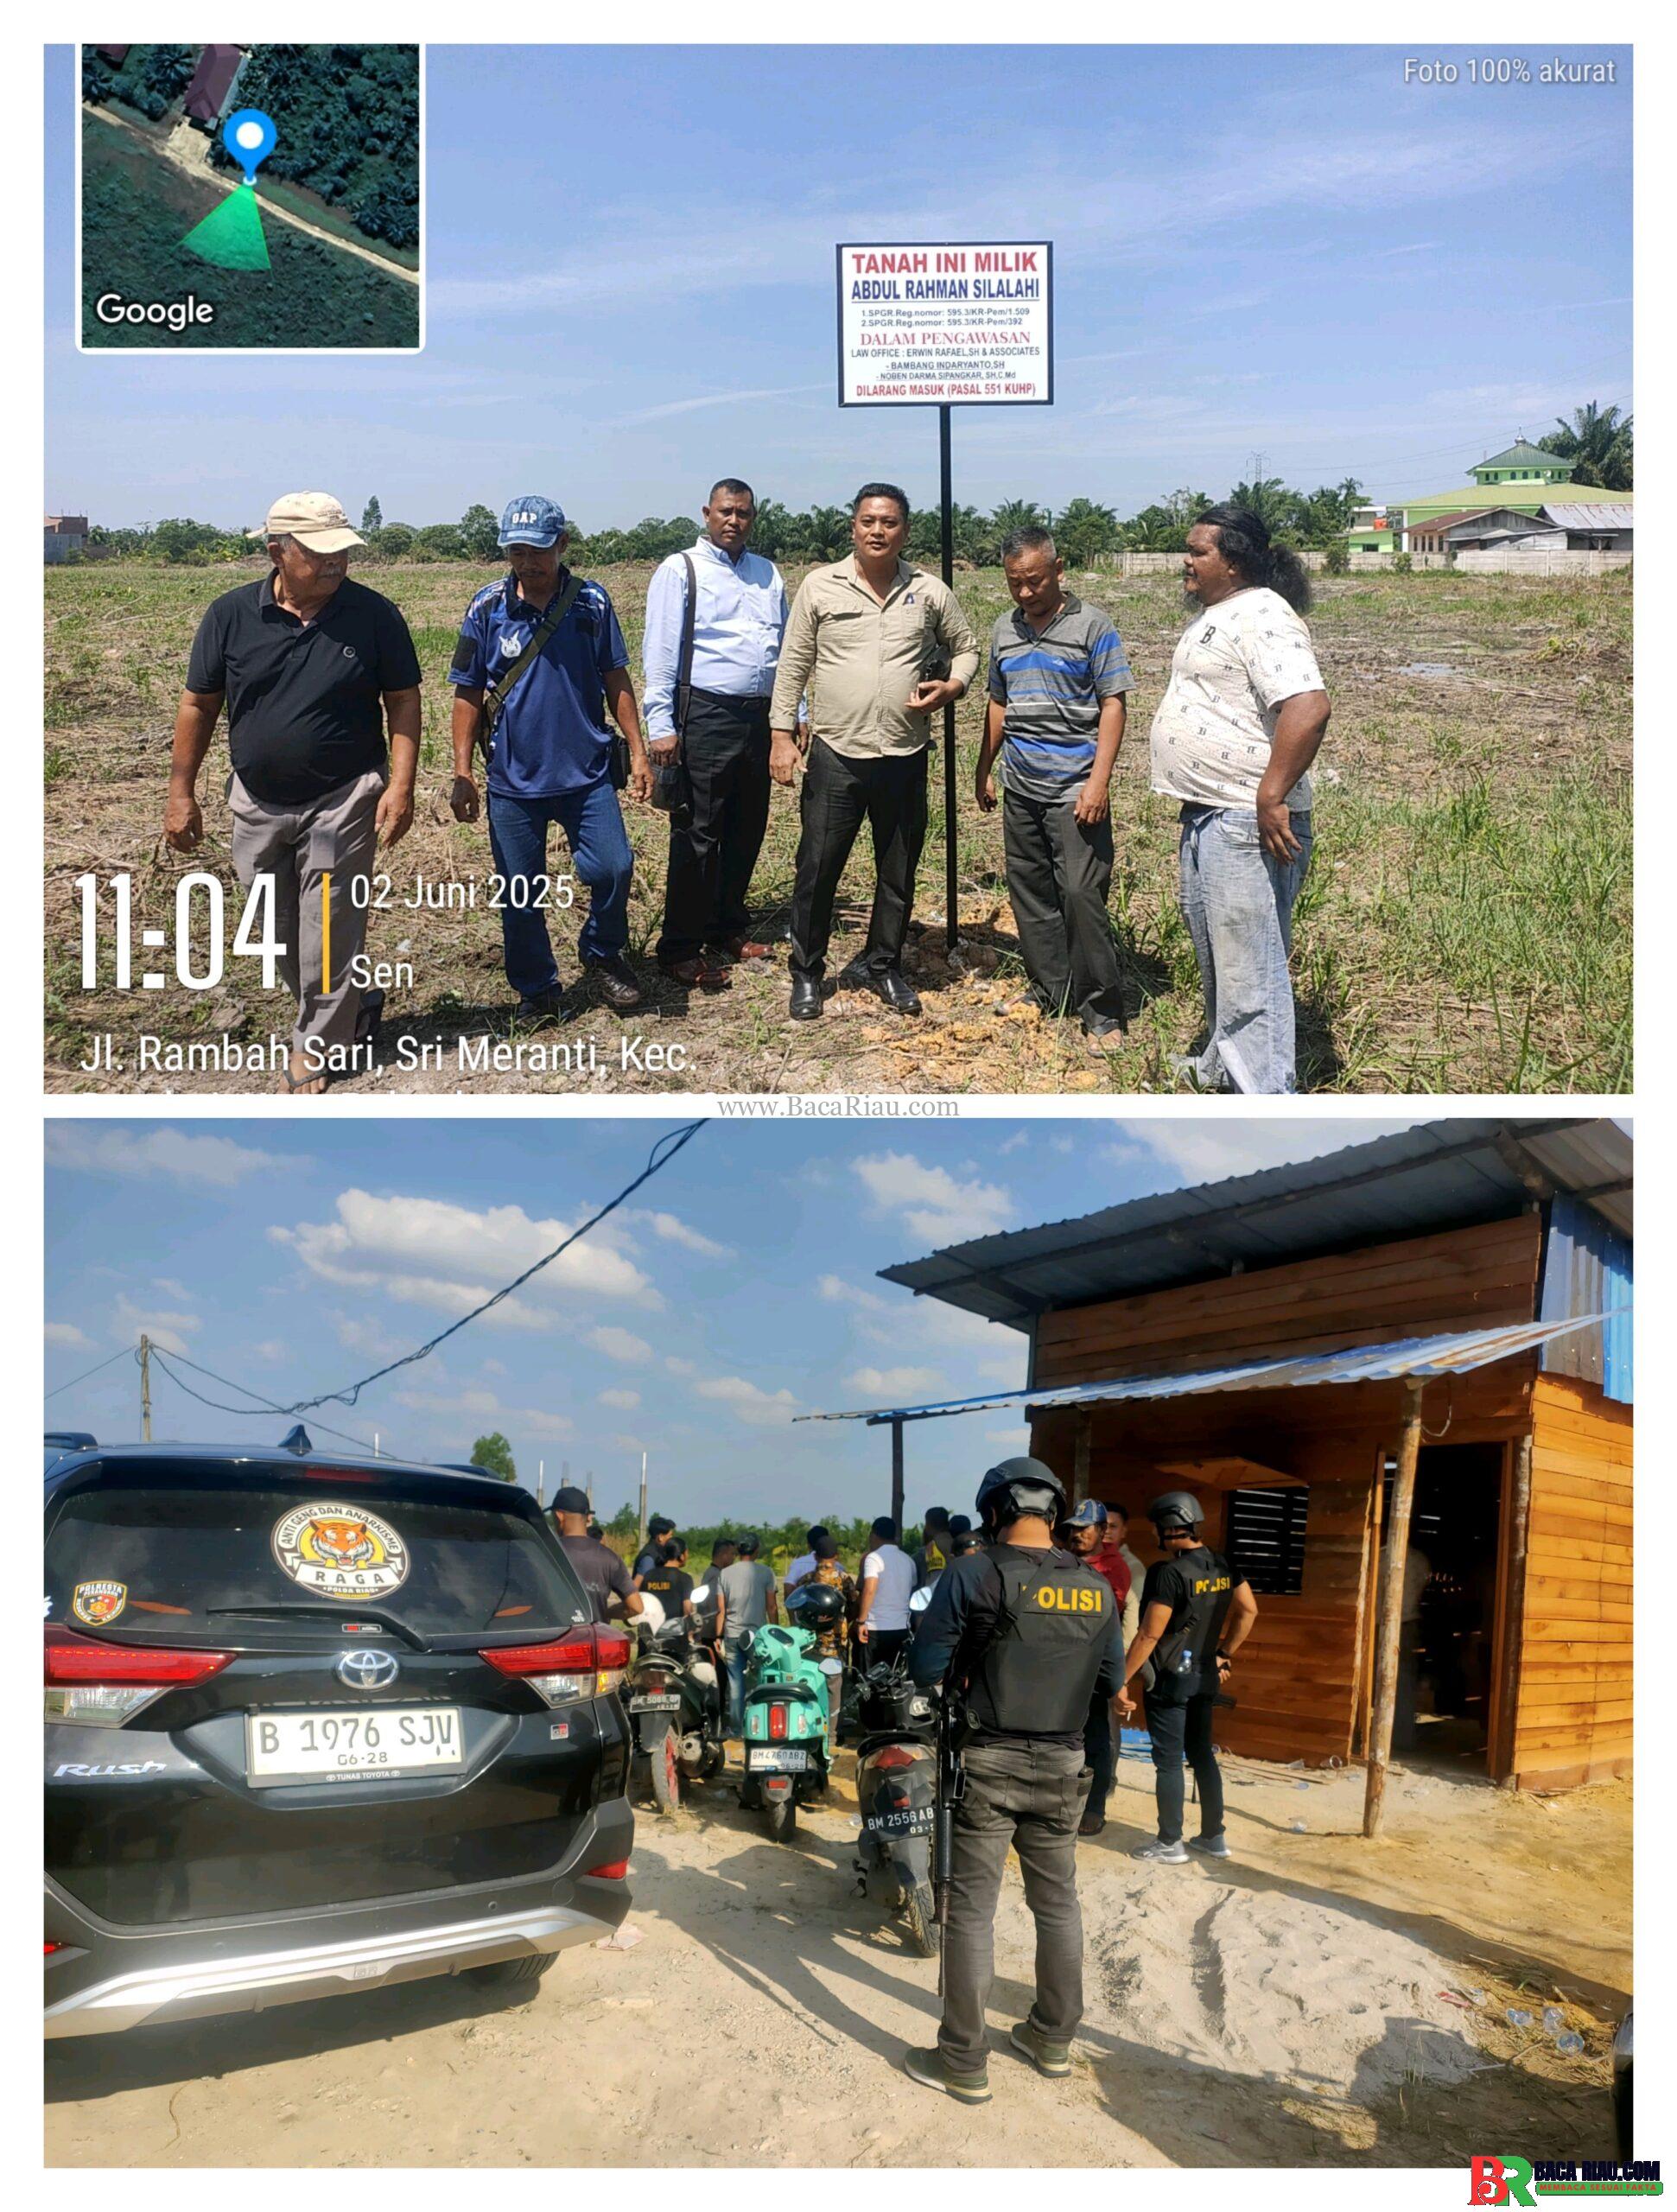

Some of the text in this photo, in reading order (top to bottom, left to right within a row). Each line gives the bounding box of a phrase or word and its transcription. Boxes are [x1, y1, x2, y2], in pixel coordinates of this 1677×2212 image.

[852, 251, 1038, 274] TANAH INI MILIK
[851, 278, 1039, 300] ABDUL RAHMAN SILALAHI
[860, 331, 1031, 346] DALAM PENGAWASAN
[871, 349, 899, 358] OFFICE
[906, 348, 933, 357] ERWIN
[981, 347, 988, 356] &
[989, 346, 1039, 356] ASSOCIATES
[856, 383, 1036, 397] DILARANG MASUK (PASAL 551 KUHP)
[282, 1507, 399, 1550] ANTI GENG DAN ANARKISME
[315, 1572, 384, 1584] RAGA
[1023, 1585, 1102, 1612] OLISI
[260, 1722, 279, 1753] B
[300, 1718, 379, 1751] 1976
[753, 1751, 764, 1759] BM
[868, 1817, 883, 1830] BM
[887, 1811, 918, 1827] 2556
